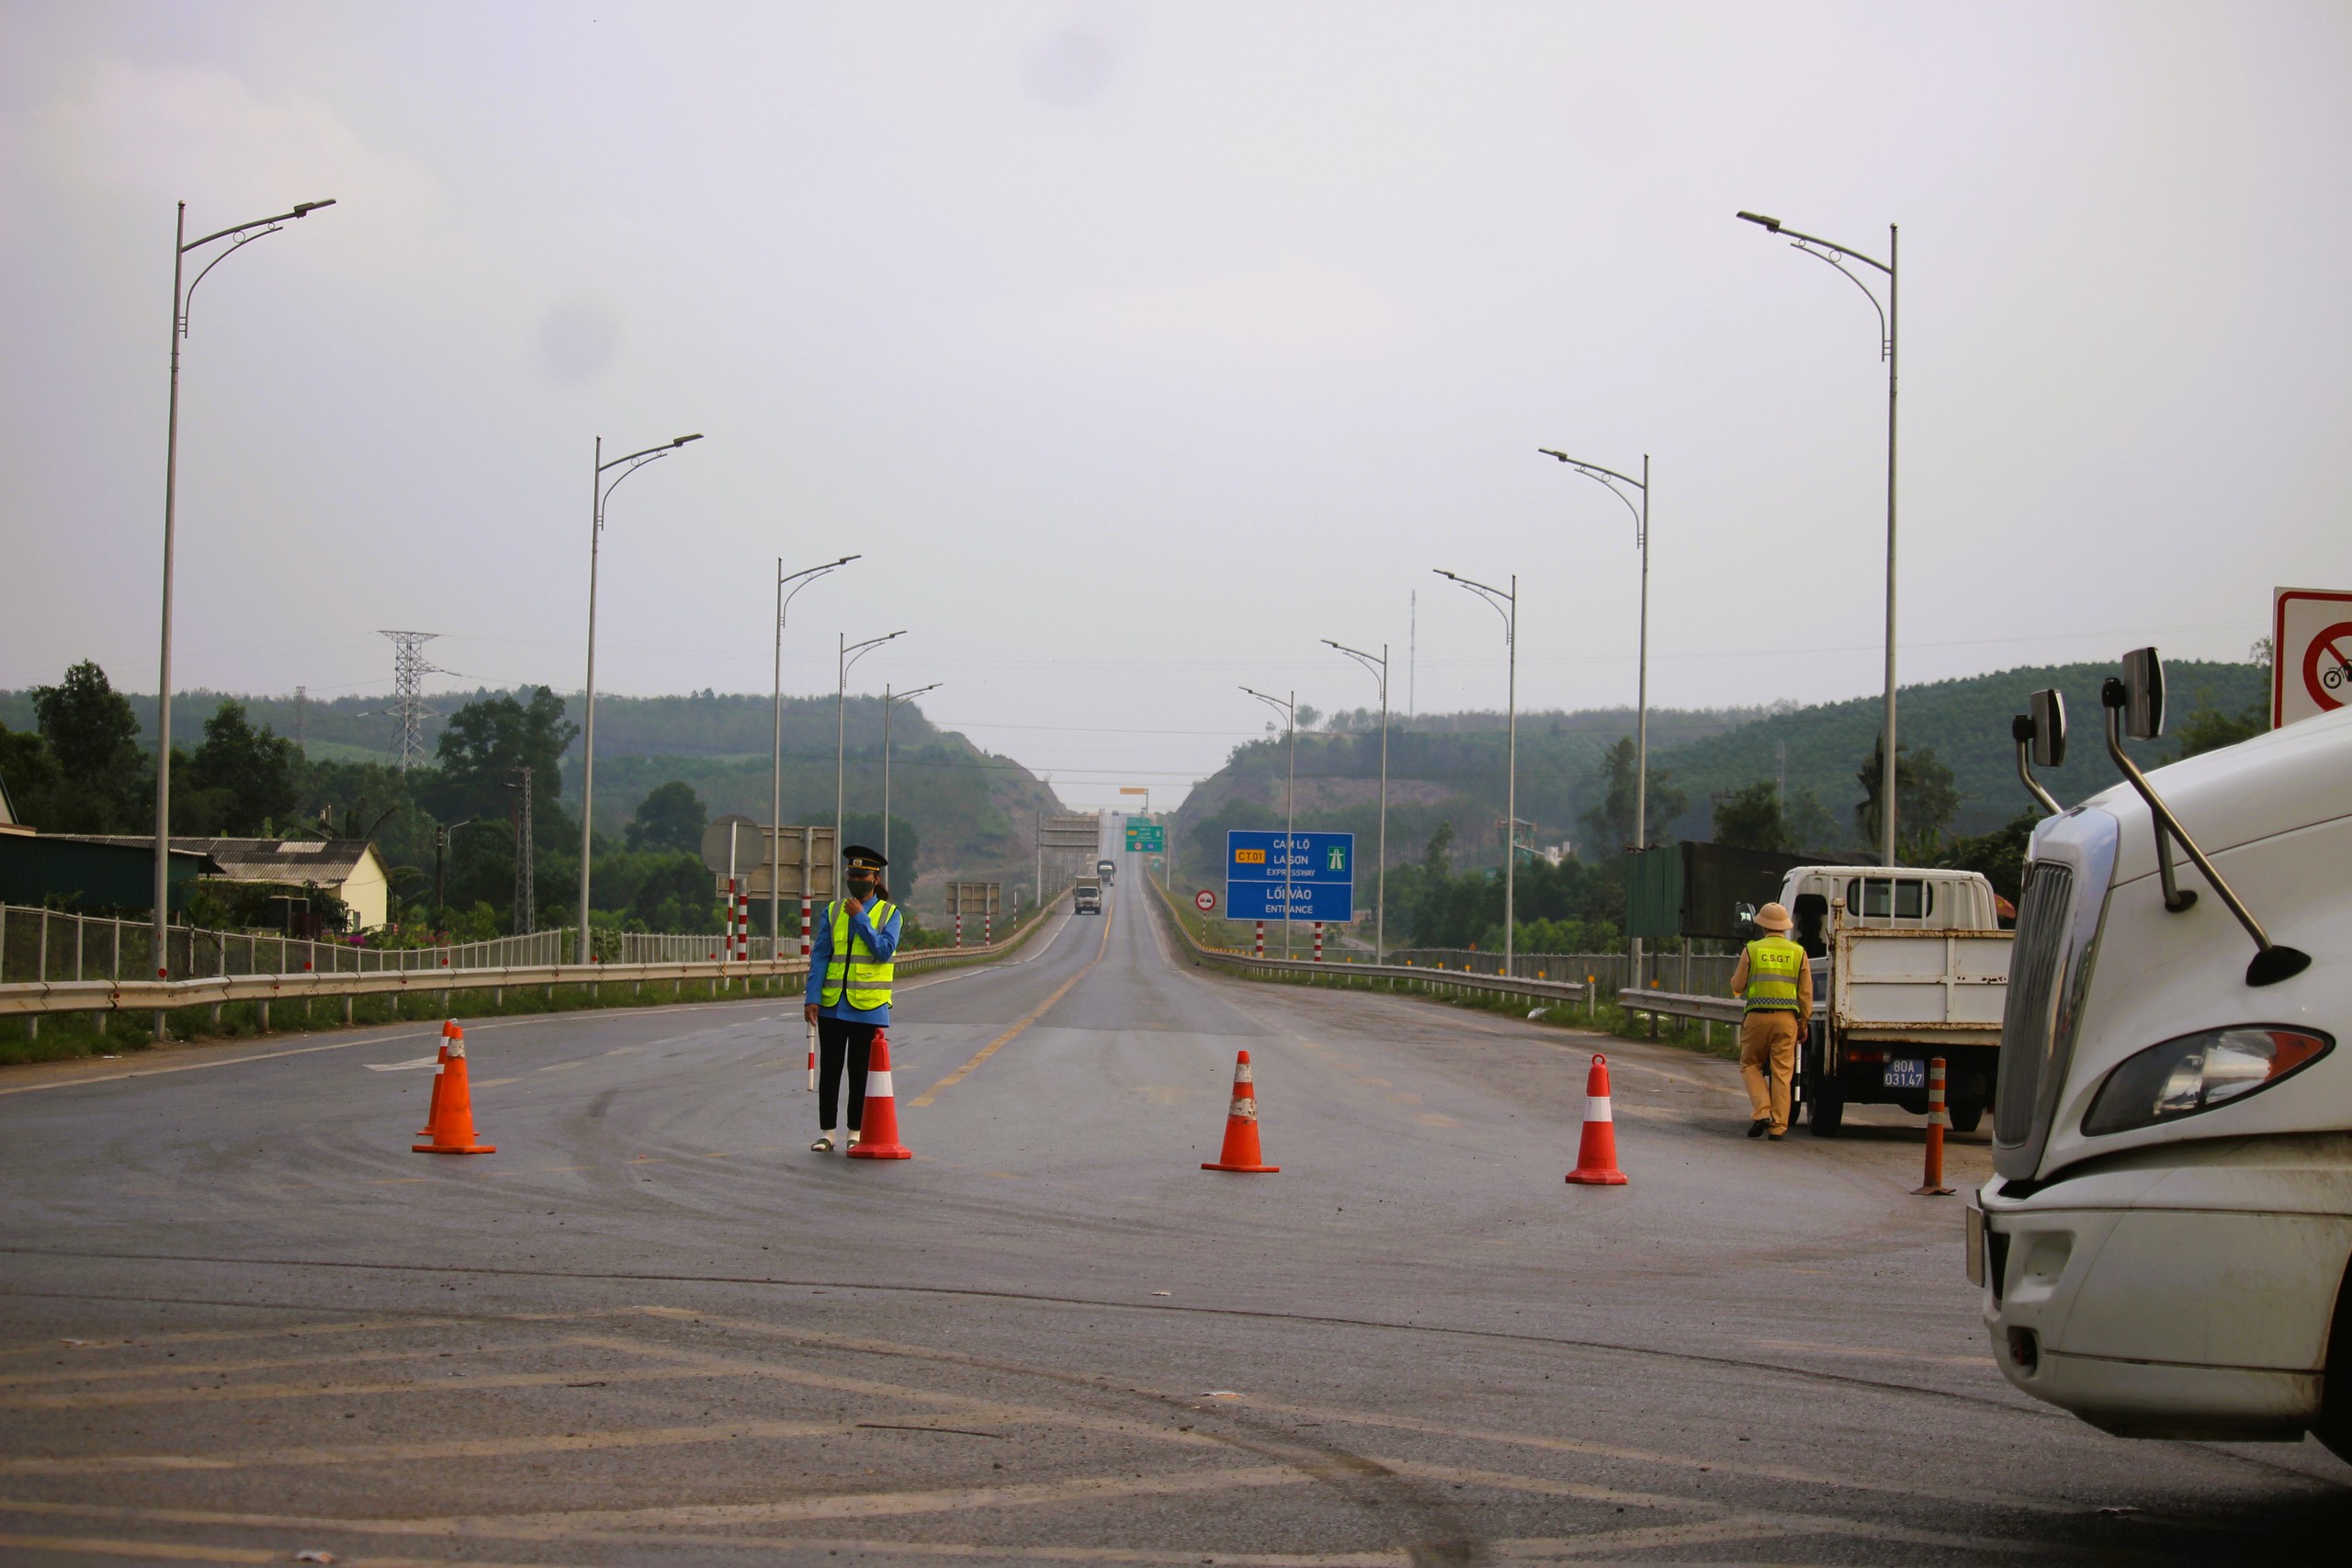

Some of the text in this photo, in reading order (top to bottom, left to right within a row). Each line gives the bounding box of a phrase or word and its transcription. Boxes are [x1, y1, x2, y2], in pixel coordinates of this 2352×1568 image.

[1296, 838, 1310, 852] LỘ
[1238, 852, 1262, 862] CT.01
[1273, 855, 1308, 865] LA SƠN
[1266, 886, 1312, 900] LỐI VÀO
[1894, 1060, 1915, 1073] 80A
[1885, 1073, 1923, 1087] 031.47
